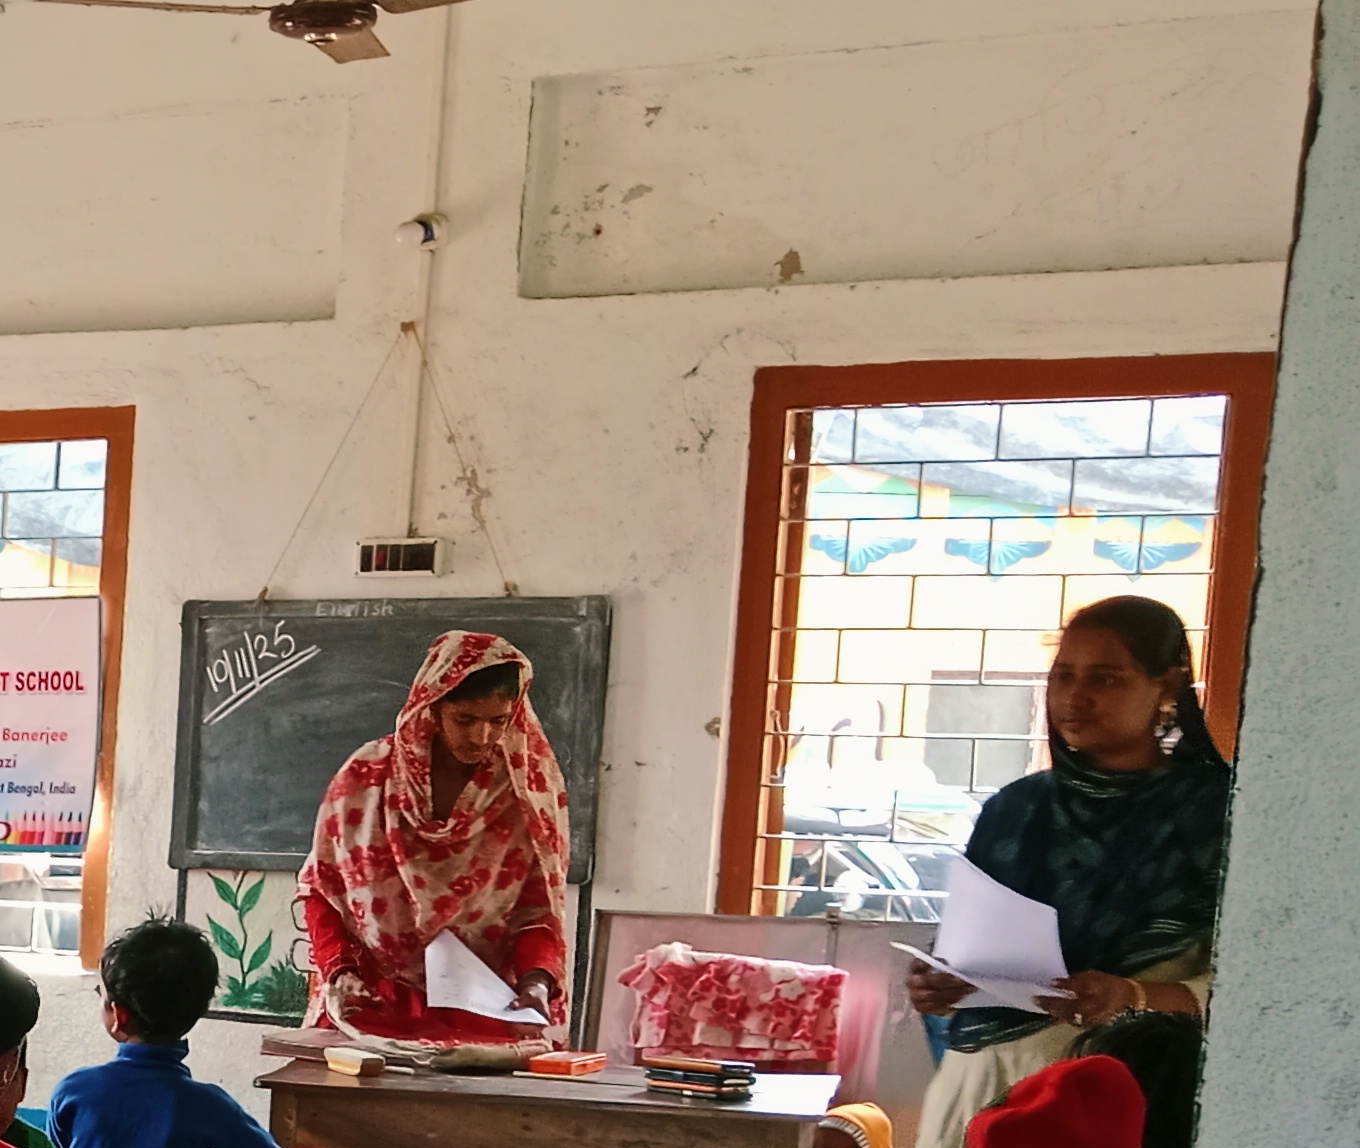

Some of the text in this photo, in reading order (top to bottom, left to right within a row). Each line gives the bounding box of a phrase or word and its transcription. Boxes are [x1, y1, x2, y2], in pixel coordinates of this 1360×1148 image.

[206, 620, 296, 692] 10/11/25
[15, 671, 85, 692] SCHOOL
[2, 727, 68, 745] Banerjee
[7, 781, 45, 797] Bengal,
[49, 782, 76, 794] India
